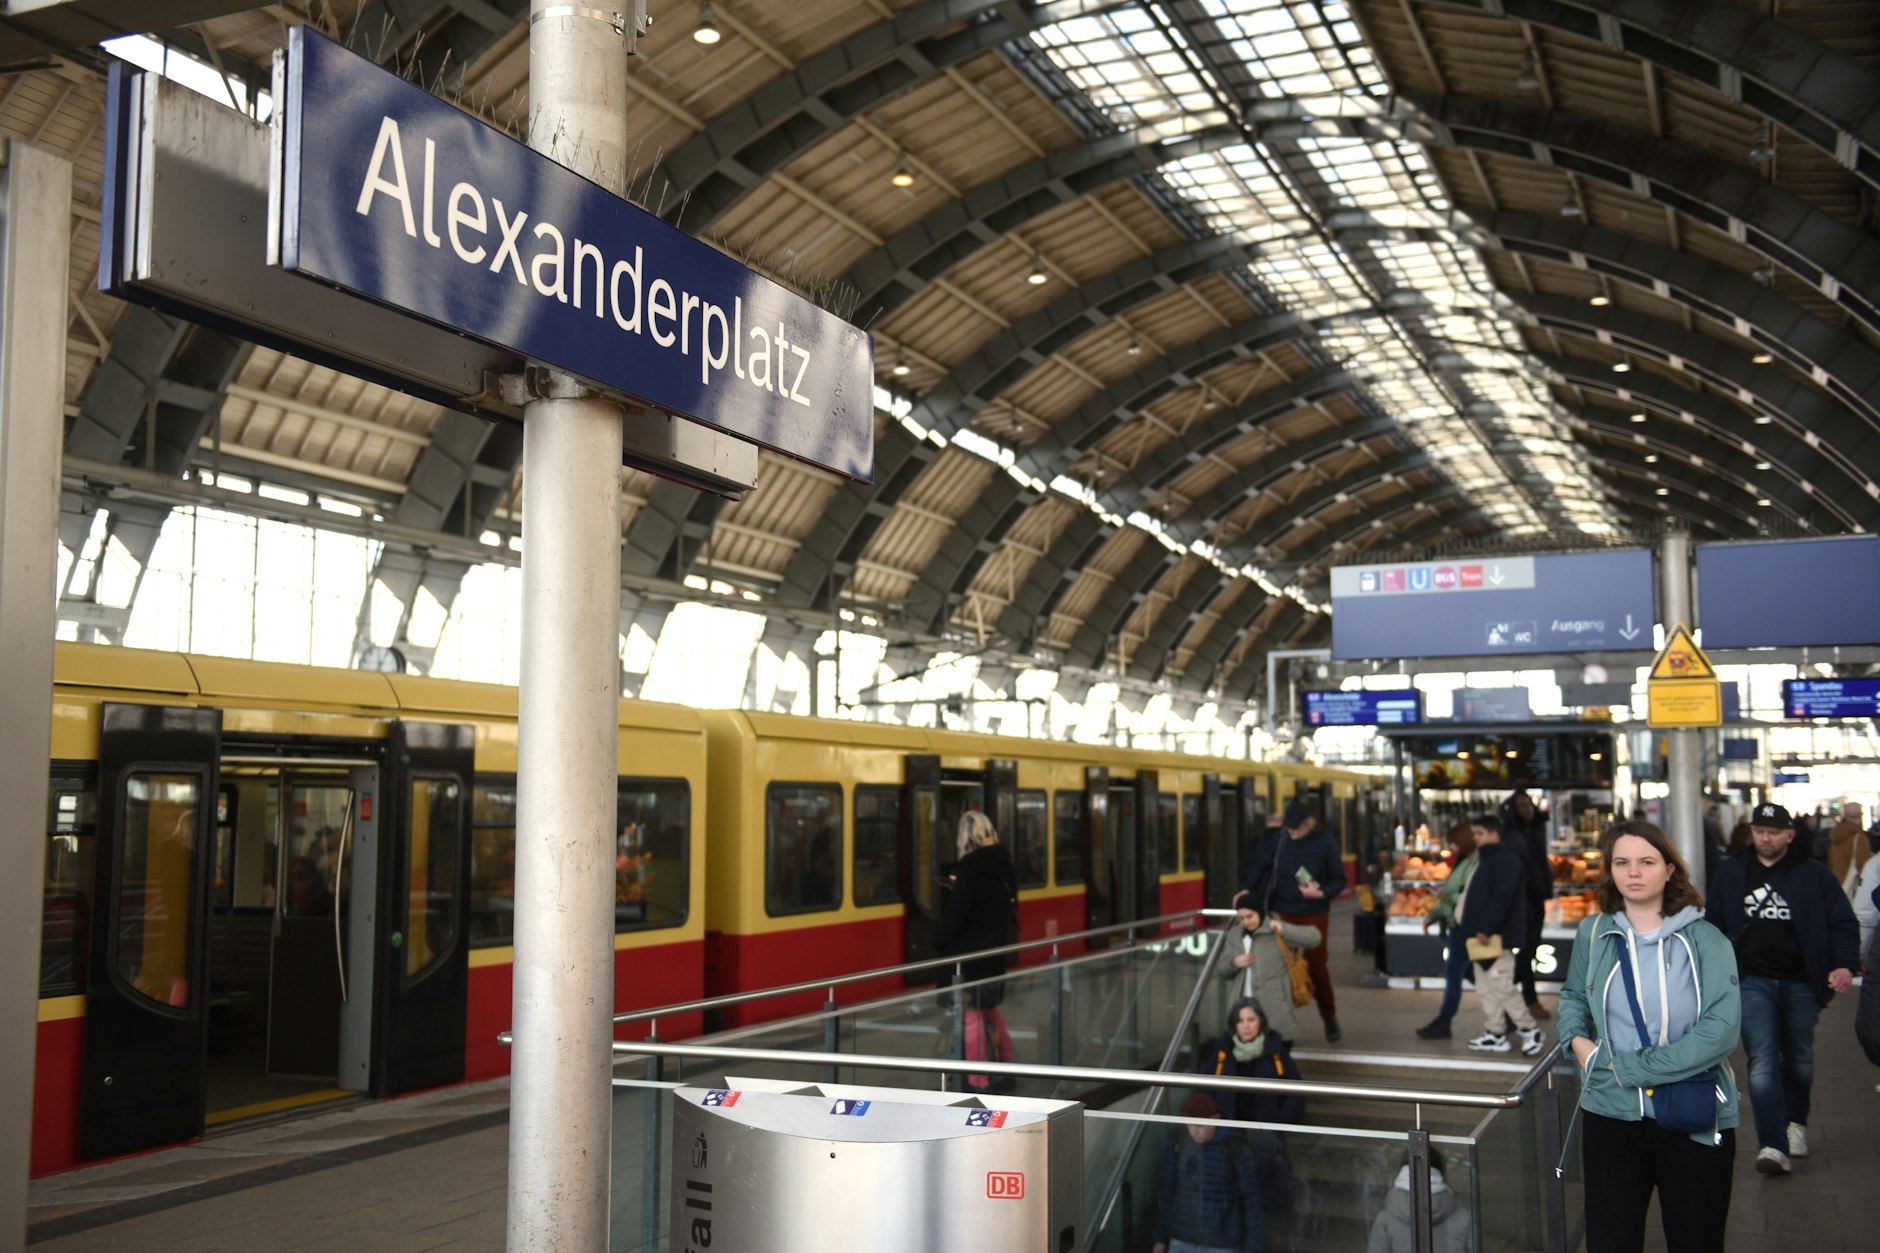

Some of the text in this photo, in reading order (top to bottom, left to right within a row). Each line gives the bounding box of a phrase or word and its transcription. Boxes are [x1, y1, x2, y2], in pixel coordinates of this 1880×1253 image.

[355, 116, 811, 407] Alexanderplatz
[1411, 569, 1428, 589] U
[1434, 572, 1456, 584] BUS
[1551, 619, 1605, 634] Ausgang
[990, 1175, 1021, 1196] DB
[685, 1179, 713, 1253] all
